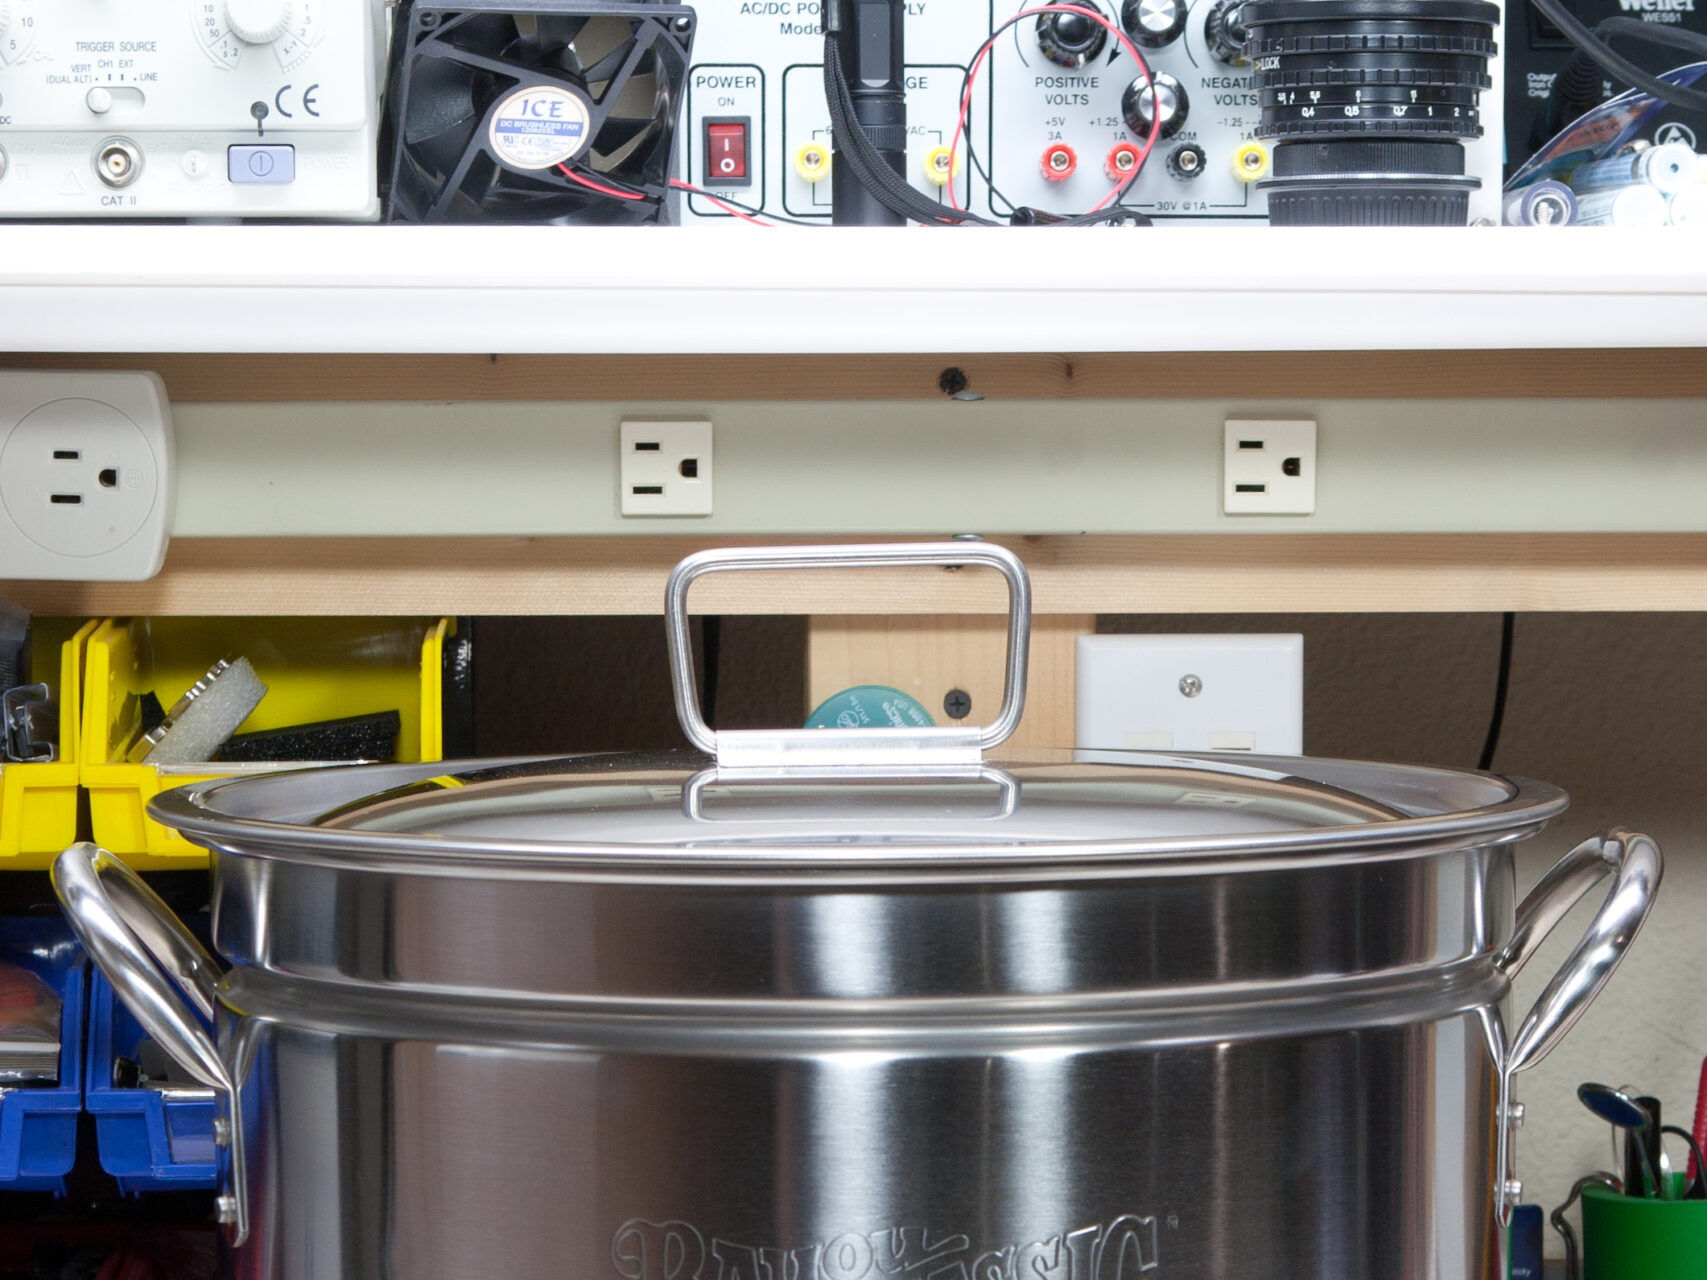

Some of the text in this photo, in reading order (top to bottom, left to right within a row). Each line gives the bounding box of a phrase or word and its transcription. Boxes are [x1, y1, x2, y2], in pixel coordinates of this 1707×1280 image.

[203, 4, 214, 13] 10
[739, 2, 791, 15] AC/DC
[21, 17, 34, 28] 10
[205, 18, 216, 27] 20
[1641, 12, 1682, 23] WES51
[209, 29, 220, 38] 50
[780, 23, 821, 35] Mode
[10, 40, 16, 50] 5
[76, 41, 157, 52] TRIGGER SOURCE
[71, 64, 91, 73] VERT
[98, 60, 114, 69] CH1
[119, 60, 134, 69] EXT
[1261, 57, 1280, 70] LOCK
[46, 74, 92, 84] (DUAL ALT)
[140, 73, 158, 82] LINE
[696, 77, 757, 88] POWER
[1035, 77, 1100, 88] POSITIVE
[1201, 77, 1248, 88] NEGAT
[718, 97, 735, 106] ON
[1045, 94, 1089, 105] VOLTS
[1214, 94, 1258, 105] VOLTS
[521, 98, 565, 118] ICE
[500, 120, 513, 128] DC
[514, 121, 561, 130] BRUSHLESS
[563, 123, 580, 131] FAN
[1045, 117, 1066, 127] +5V
[1048, 131, 1063, 141] 3A
[1113, 131, 1127, 141] 1A
[1240, 131, 1254, 141] 1A
[101, 196, 124, 206] CAT
[1156, 201, 1178, 211] 30V
